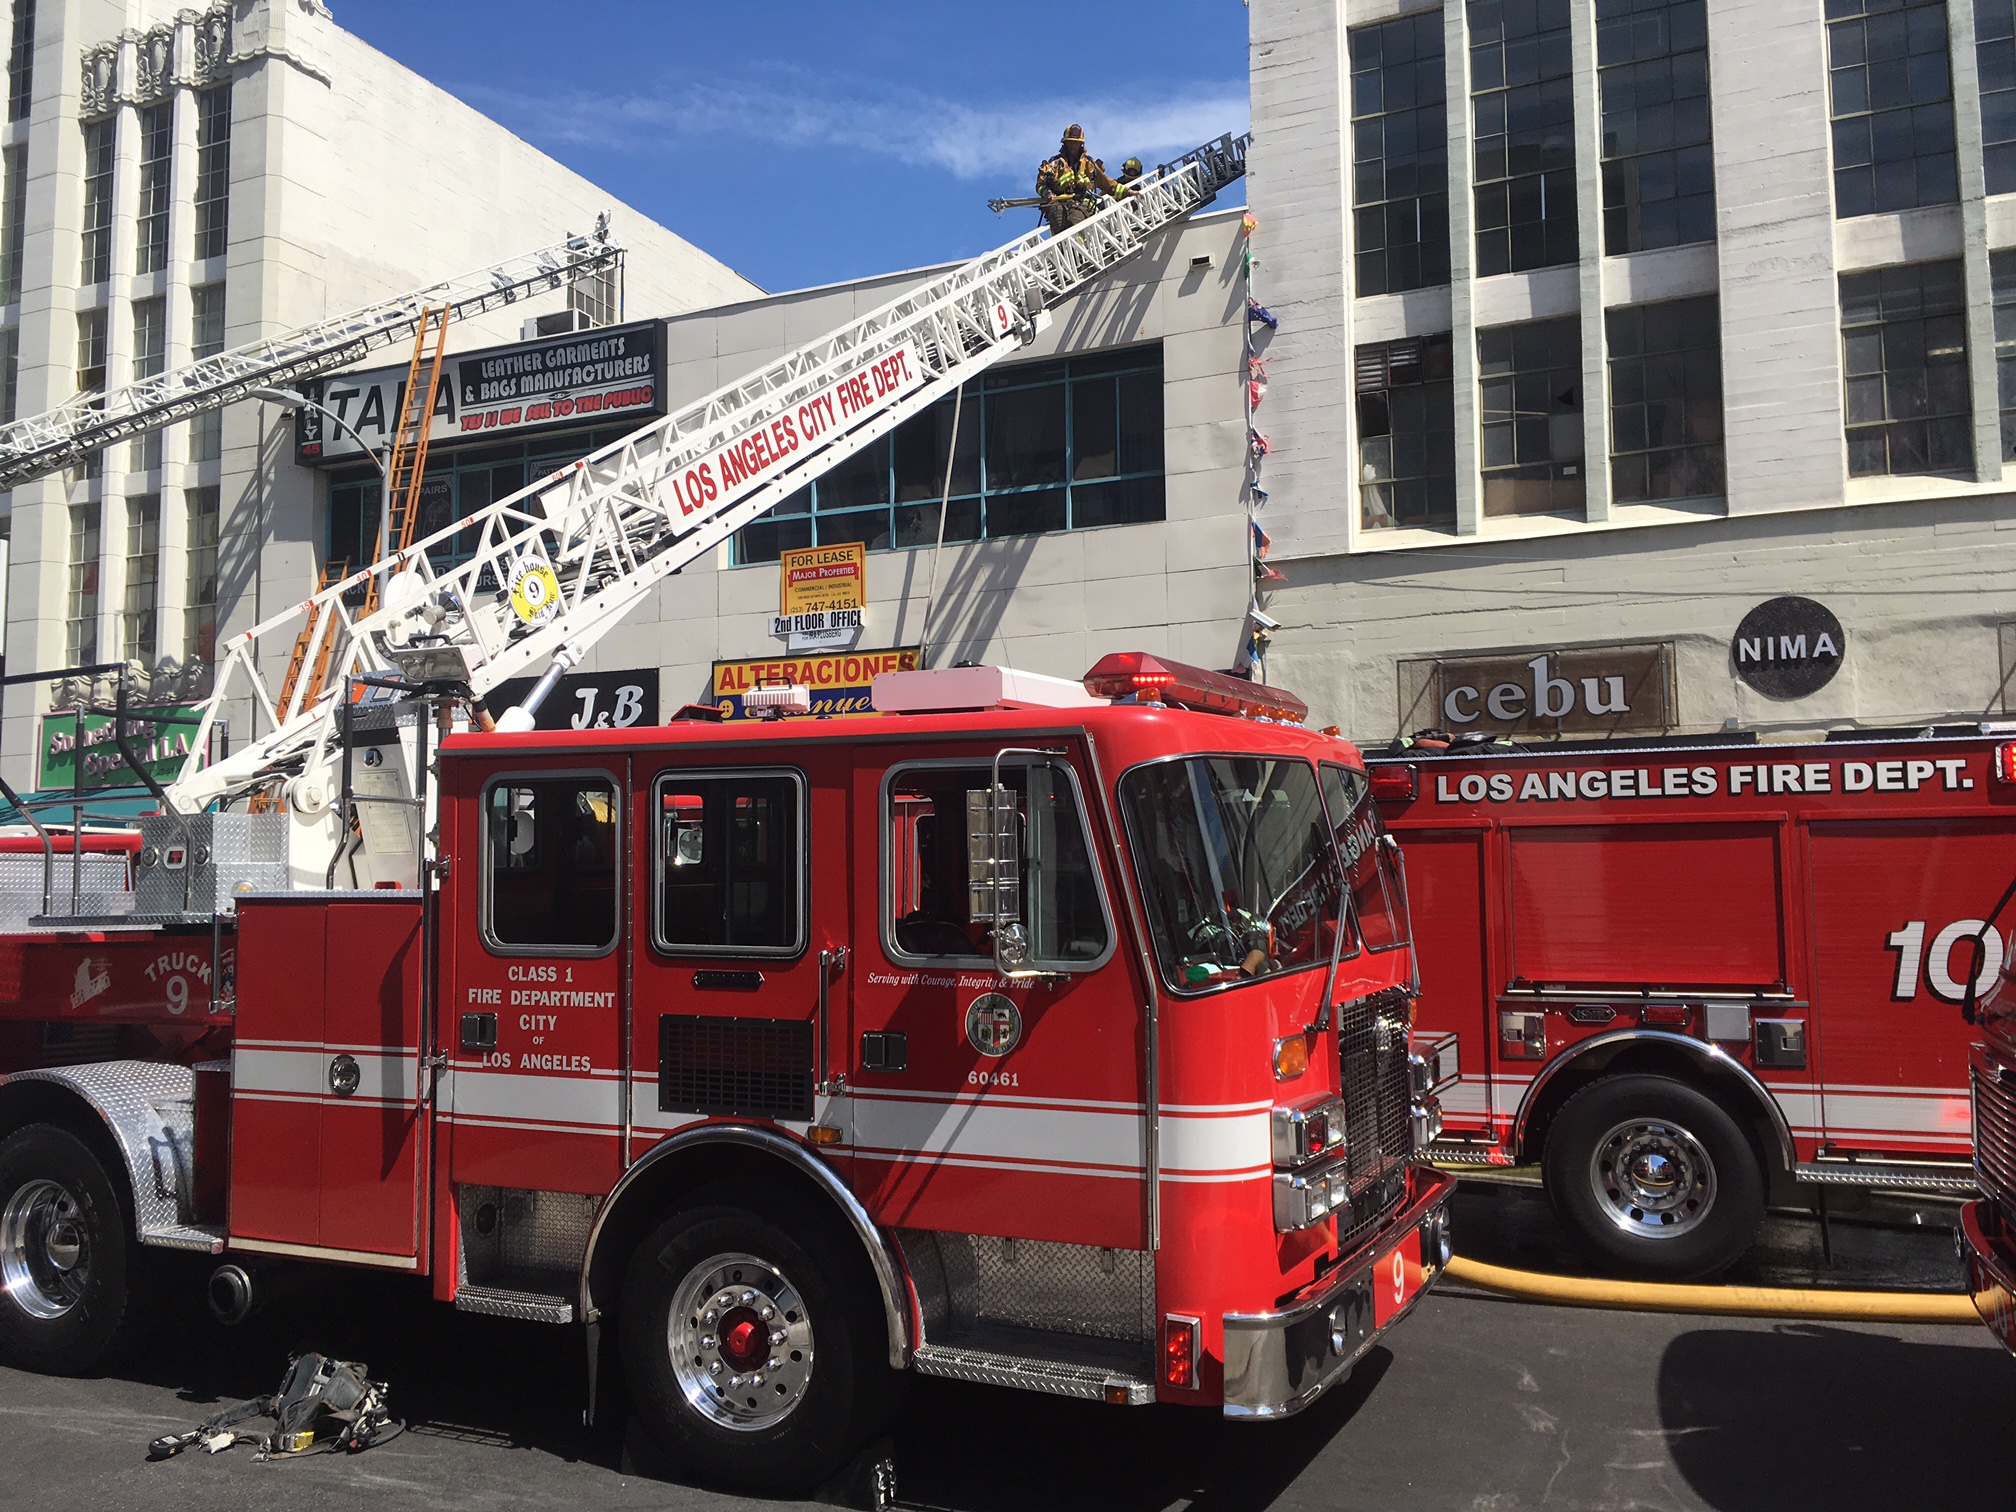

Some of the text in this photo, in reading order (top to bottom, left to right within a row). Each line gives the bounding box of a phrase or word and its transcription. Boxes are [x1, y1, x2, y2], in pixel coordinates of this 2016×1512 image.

[997, 303, 1008, 330] 9
[481, 336, 625, 379] LEATHER GARMENTS
[465, 354, 650, 402] & BAGS MANUFACTURERS
[329, 373, 456, 441] TALA
[460, 412, 482, 432] YES
[500, 408, 521, 427] WE
[526, 402, 552, 423] SELL
[553, 399, 574, 418] TO
[575, 393, 601, 413] THE
[603, 386, 654, 410] PUBLIC
[672, 349, 914, 517] LOS ANGELES CITY FIRE DEPT.
[303, 443, 320, 455] 45
[461, 518, 470, 528] 50
[791, 550, 854, 568] FOR LEASE
[356, 572, 368, 582] 40
[792, 565, 855, 581] MAJOR PROPERTIES
[529, 580, 540, 599] 9
[794, 584, 825, 593] COMMERCIAL
[828, 582, 852, 590] INDUSTRIAL
[299, 602, 310, 613] 35
[805, 598, 859, 613] 747-4151
[774, 610, 862, 634] 2nd FLOOR OFFICE
[1738, 632, 1838, 663] NIMA
[719, 653, 915, 691] ALTERACIONES
[1443, 655, 1631, 723] cebu
[1437, 759, 1974, 802] LOS ANGELES FIRE DEPT.
[144, 952, 213, 985] TRUCK
[1889, 919, 2004, 1000] 10
[508, 965, 573, 983] CLASS 1
[867, 972, 1035, 990] Serving with Courage, Integrity & Pride
[166, 975, 189, 1015] 9
[468, 988, 615, 1008] FIRE DEPARTMENT
[519, 1014, 558, 1031] CITY
[532, 1036, 545, 1045] OF
[482, 1052, 591, 1072] LOS ANGELES
[968, 1070, 1019, 1087] 60461
[1393, 1251, 1405, 1304] 9
